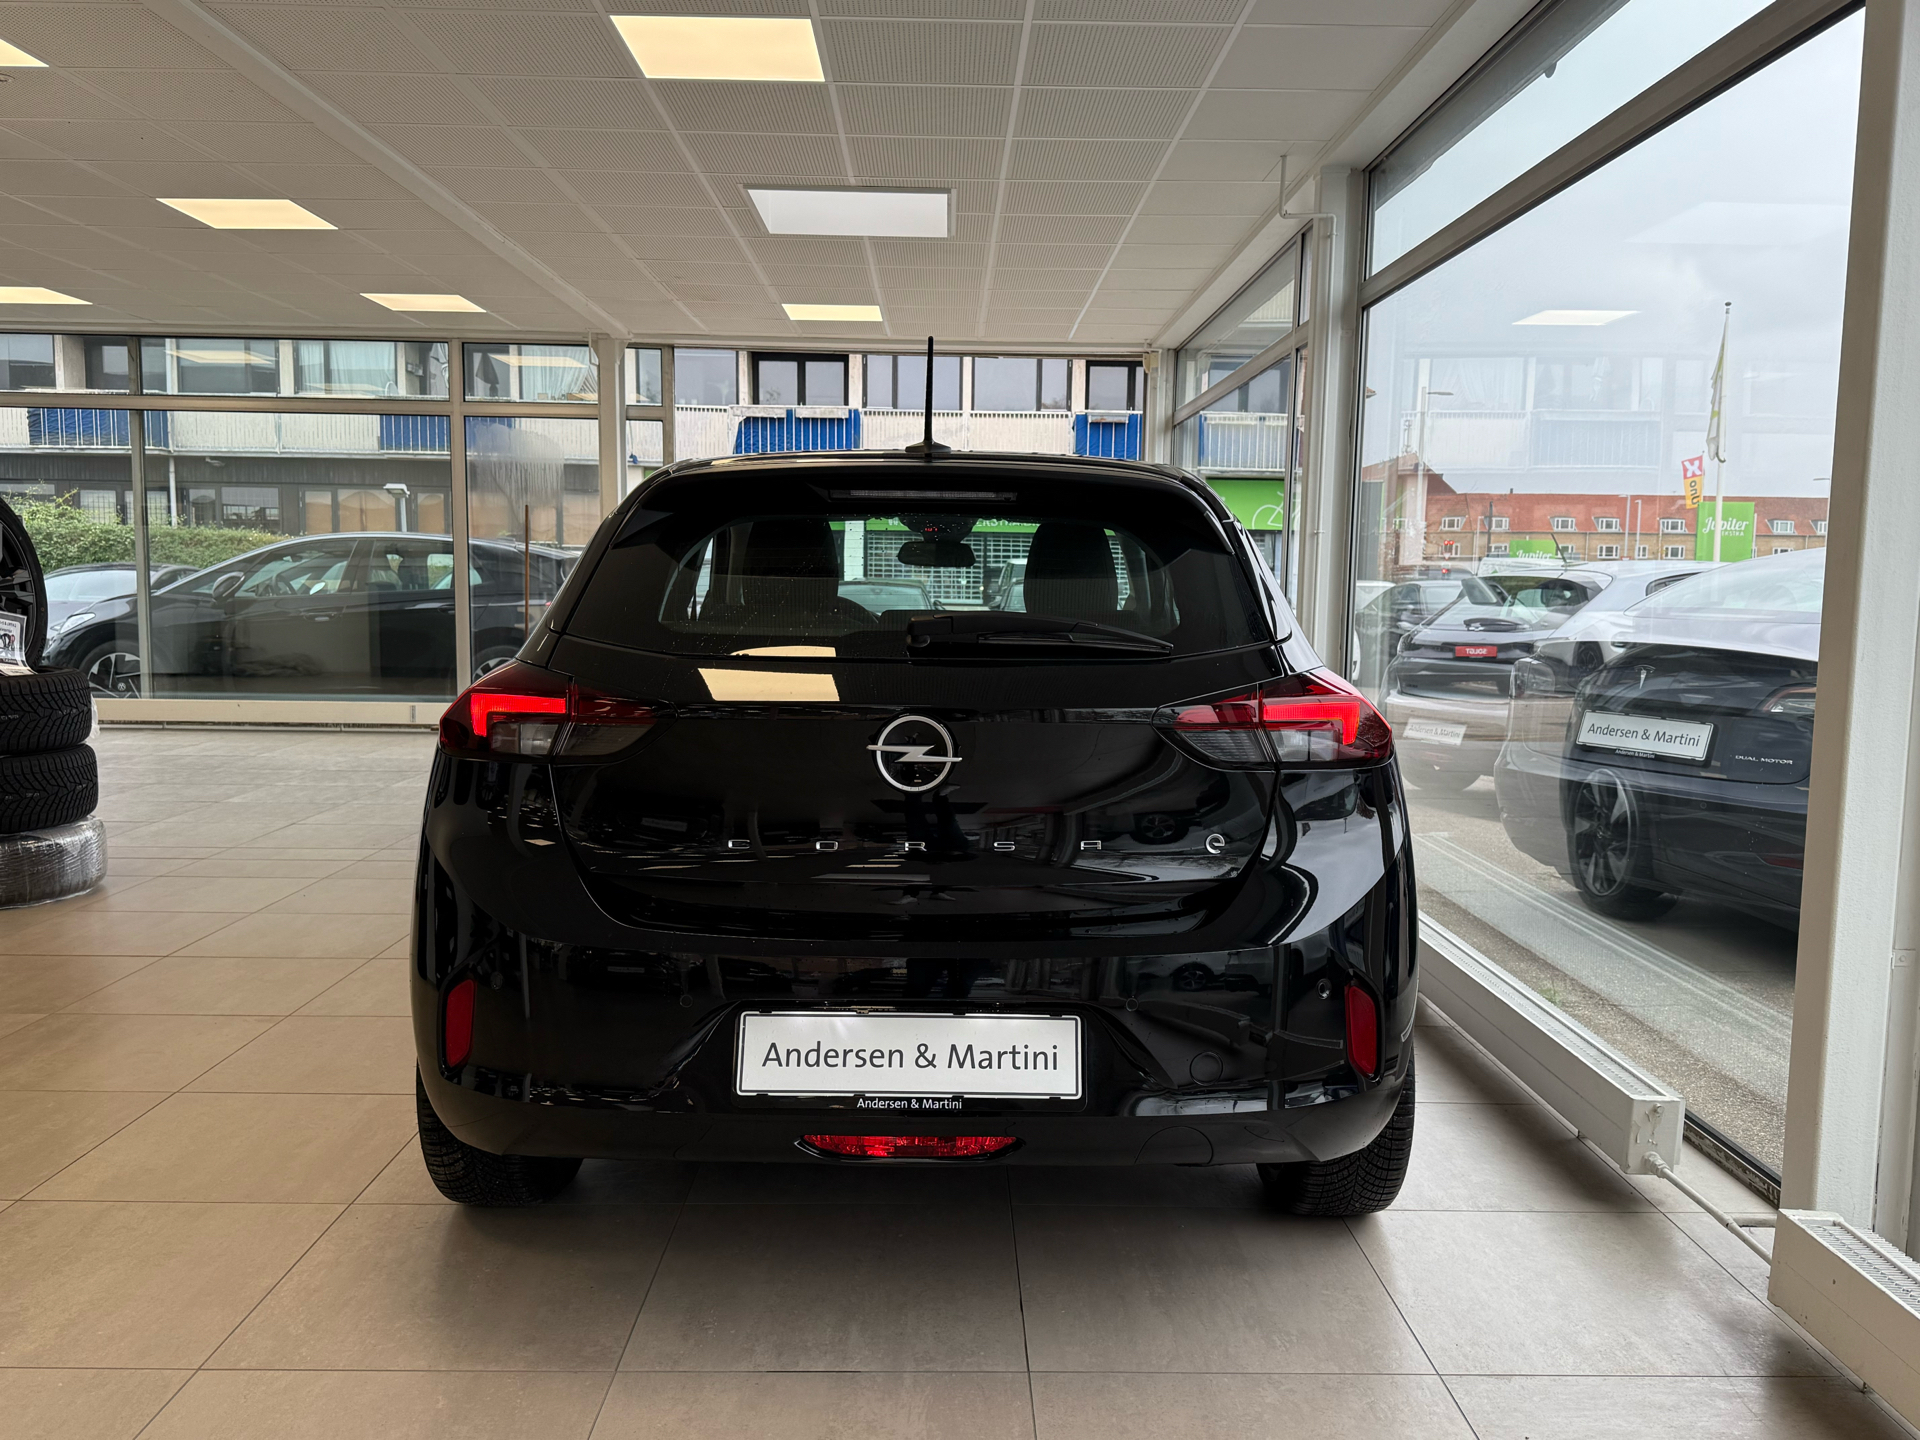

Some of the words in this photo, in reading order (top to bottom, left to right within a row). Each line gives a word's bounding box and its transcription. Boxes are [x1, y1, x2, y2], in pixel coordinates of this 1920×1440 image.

[1587, 722, 1639, 740] Andersen
[1641, 728, 1650, 741] &
[1653, 730, 1701, 747] Martini
[1735, 754, 1759, 762] DUAL
[1760, 757, 1793, 765] MOTOR
[727, 839, 1102, 852] CORSA
[761, 1040, 904, 1069] Andersen
[914, 1042, 937, 1069] &
[947, 1043, 1059, 1071] Martini
[856, 1097, 908, 1109] Andersen
[910, 1098, 920, 1109] &
[922, 1098, 962, 1110] Martini
